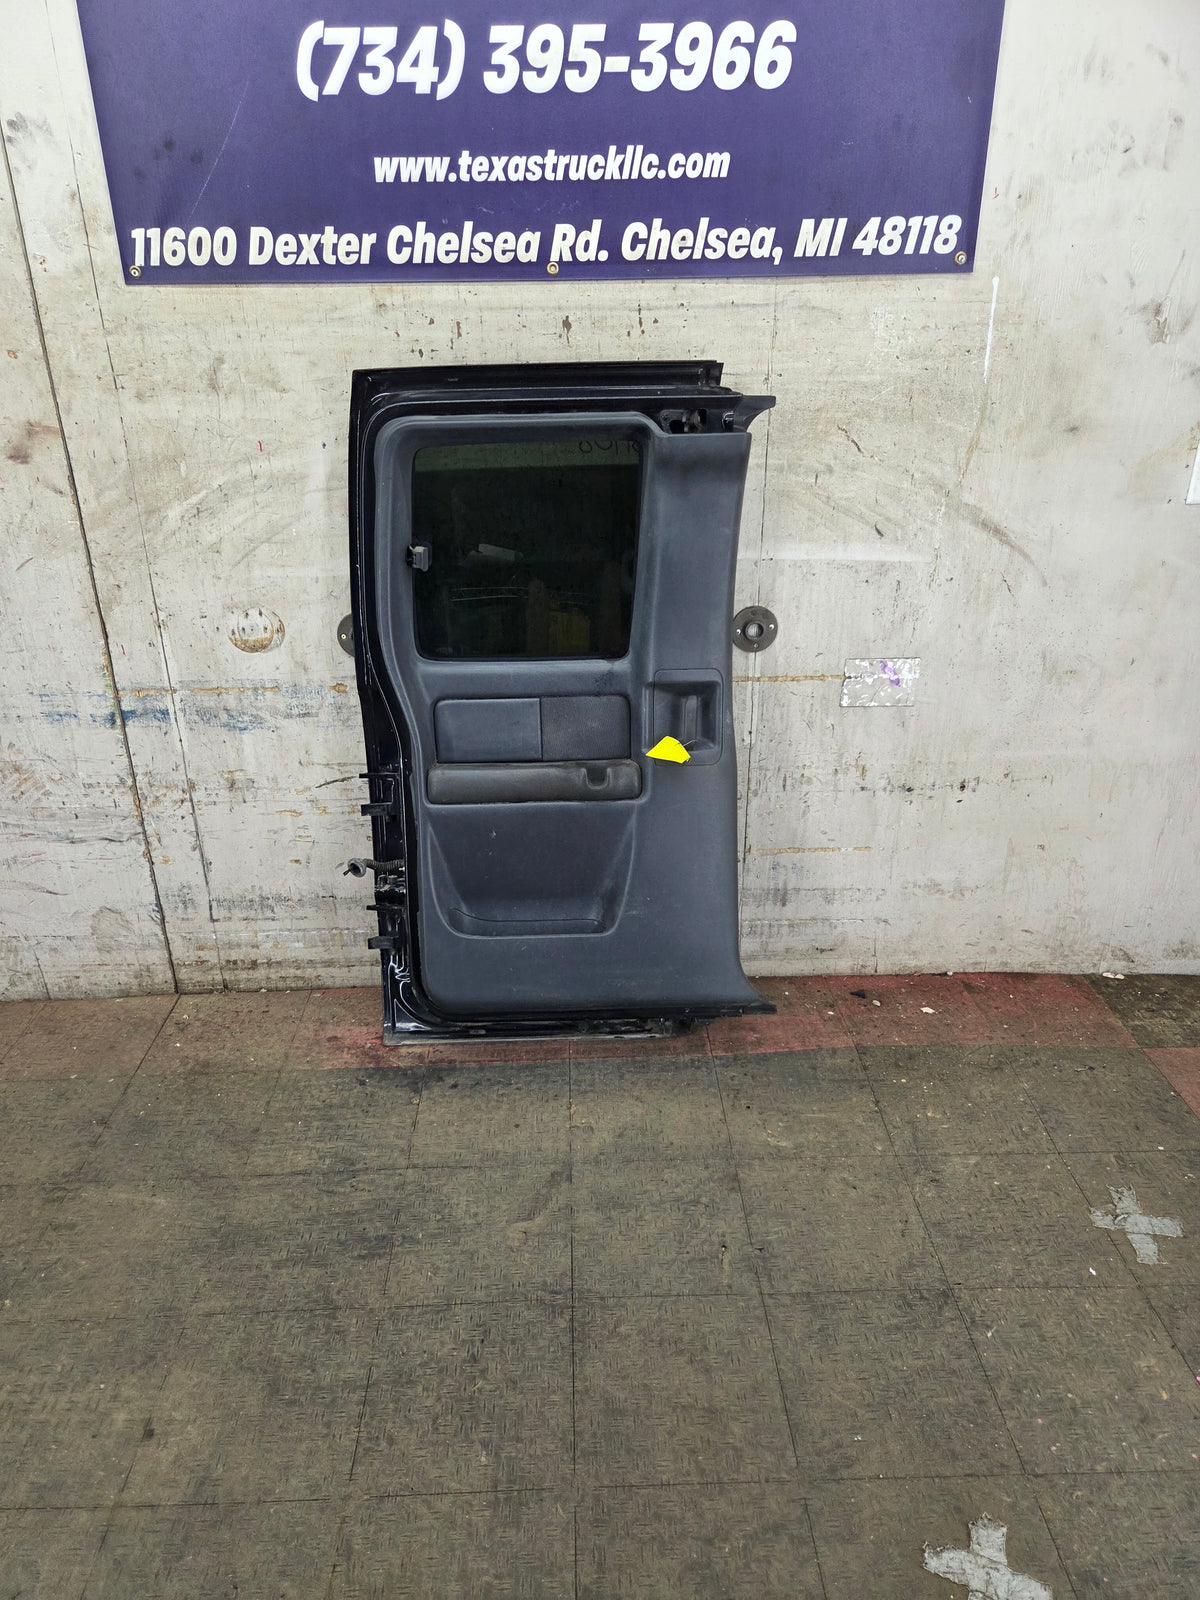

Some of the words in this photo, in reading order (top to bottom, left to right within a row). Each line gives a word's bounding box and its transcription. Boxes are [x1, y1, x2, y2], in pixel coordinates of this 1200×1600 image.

[296, 18, 465, 102] (734)
[483, 20, 797, 94] 395-3966
[374, 145, 731, 182] www.texastruckllc.com
[130, 226, 237, 267] 11600
[249, 226, 377, 265] Dexter
[387, 221, 541, 264] Chelsea
[550, 219, 608, 262] Rd.
[621, 217, 783, 265] Chelsea,
[794, 218, 848, 257] MI
[852, 215, 962, 255] 48118
